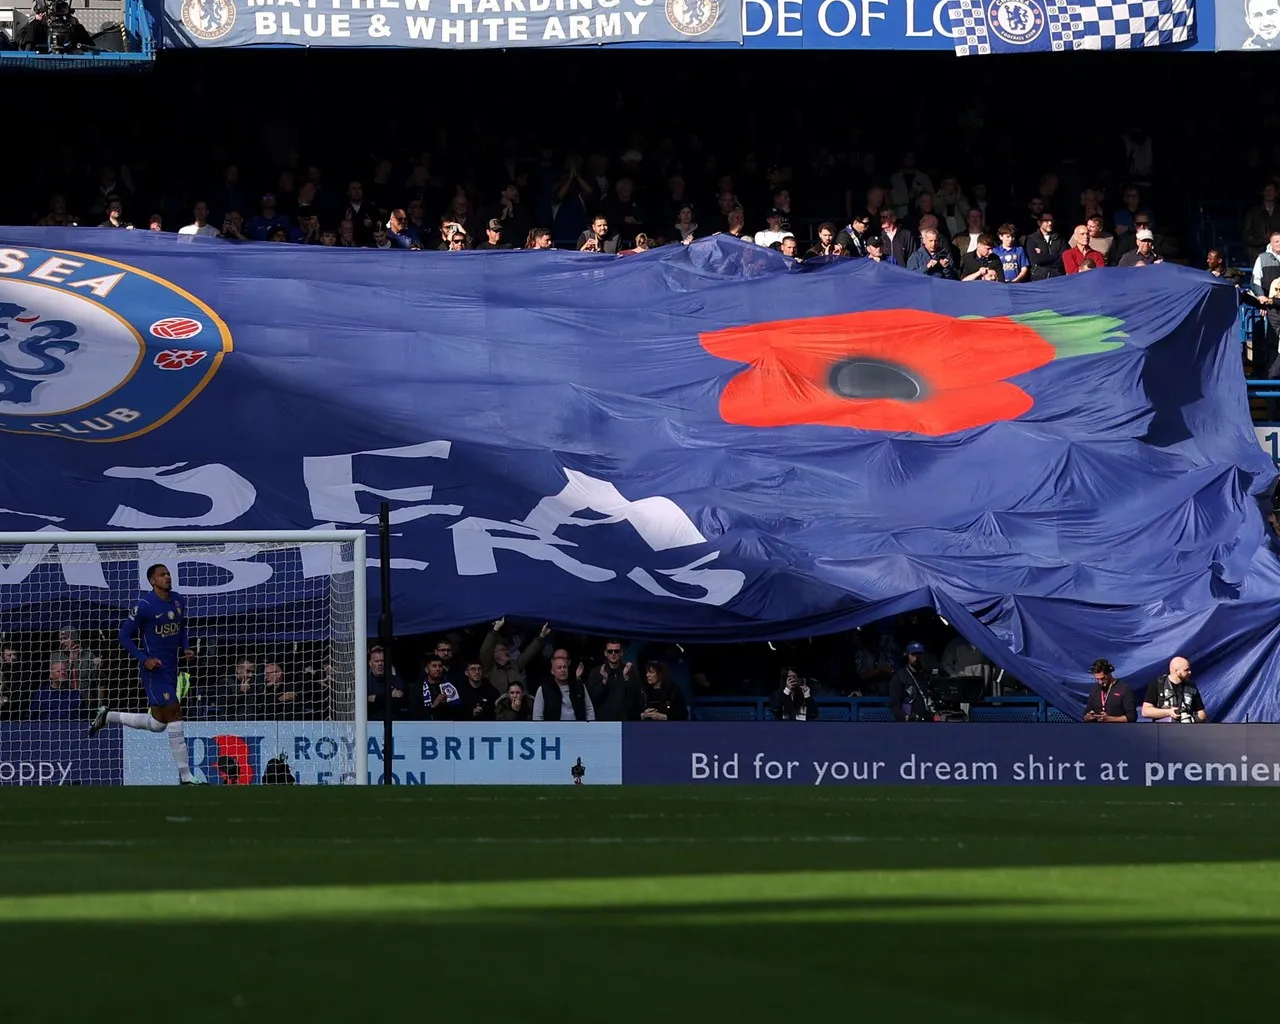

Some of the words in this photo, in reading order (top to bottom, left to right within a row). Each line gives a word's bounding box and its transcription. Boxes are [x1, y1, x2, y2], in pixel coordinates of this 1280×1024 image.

[254, 11, 351, 39] BLUE
[367, 13, 392, 39] &
[405, 15, 528, 43] WHITE
[542, 10, 648, 39] ARMY
[30, 406, 142, 435] CLUB
[421, 735, 562, 761] BRITISH
[691, 752, 739, 780] Bid
[753, 752, 800, 780] for
[813, 759, 886, 786] your
[899, 753, 998, 781] dream
[1012, 754, 1087, 782] shirt
[1100, 760, 1130, 782] at
